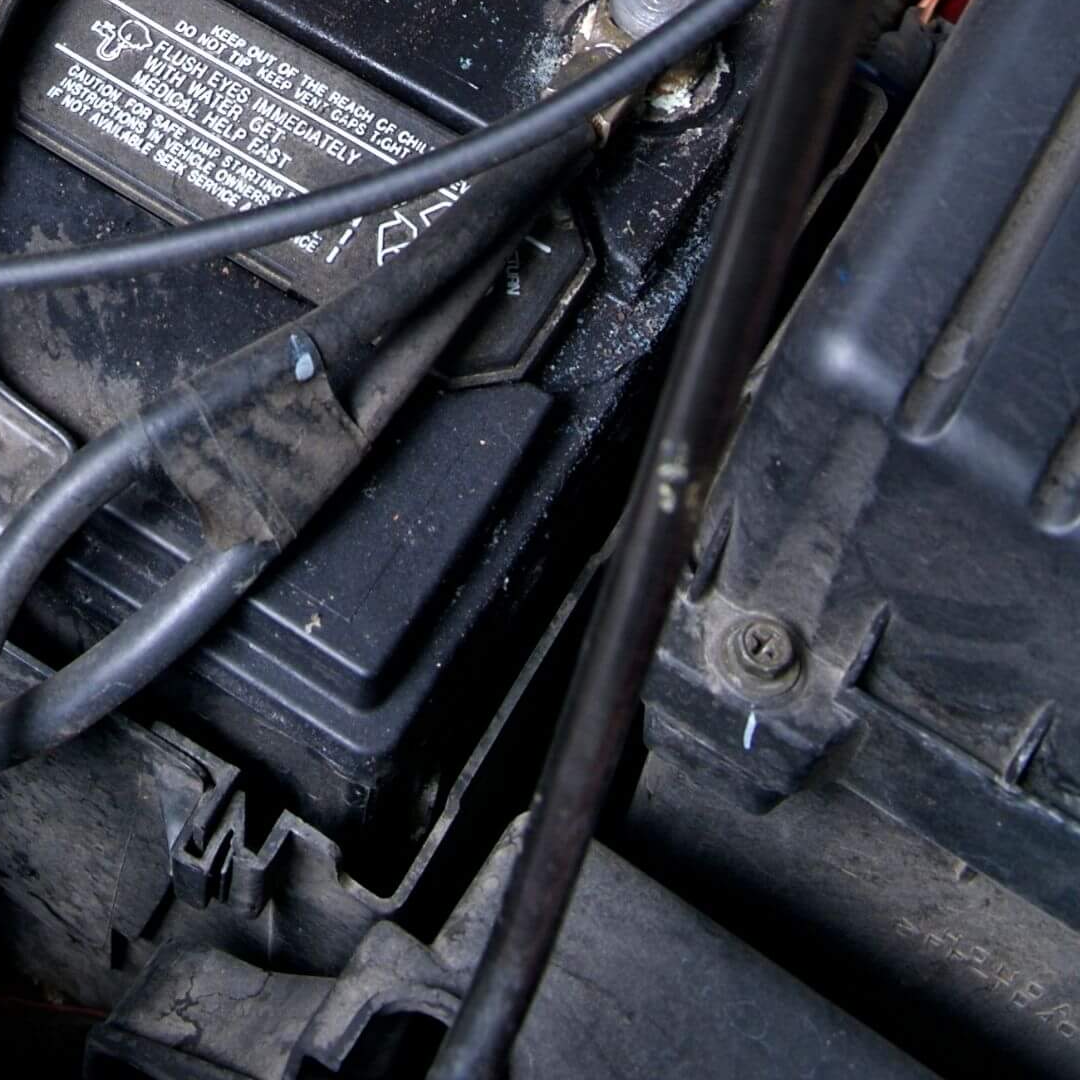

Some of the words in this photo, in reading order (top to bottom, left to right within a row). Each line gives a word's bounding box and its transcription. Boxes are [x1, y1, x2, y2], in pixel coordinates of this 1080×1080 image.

[143, 55, 186, 88] WITH
[249, 116, 286, 144] GET
[153, 40, 209, 79] FLUSH
[207, 70, 251, 104] EYES
[252, 96, 362, 166] IMMEDIATELY
[174, 20, 197, 38] DO
[197, 33, 228, 55] NOT
[229, 49, 252, 68] TIP
[256, 66, 293, 91] KEEP
[210, 25, 247, 49] KEEP
[247, 45, 278, 67] OUT
[277, 62, 300, 78] OF
[301, 73, 329, 98] THE
[328, 91, 376, 124] REACH
[397, 130, 436, 155] CHIL
[46, 85, 64, 99] IF
[61, 94, 91, 117] NOT
[88, 112, 155, 156] AVAILABLE
[153, 149, 188, 176] SEEK
[187, 170, 241, 208] SERVICE
[60, 77, 147, 134] INSTRUCTIONS
[147, 128, 164, 145] IN
[163, 137, 216, 175] VEHICLE
[68, 64, 122, 102] CAUTION
[124, 97, 152, 120] FOR
[151, 113, 187, 140] SAFE
[184, 135, 222, 159] JUMP
[221, 154, 285, 199] STARTING
[131, 69, 199, 119] MEDICAL
[201, 111, 247, 142] HELP
[247, 136, 293, 169] FAST
[506, 250, 521, 297] TURN
